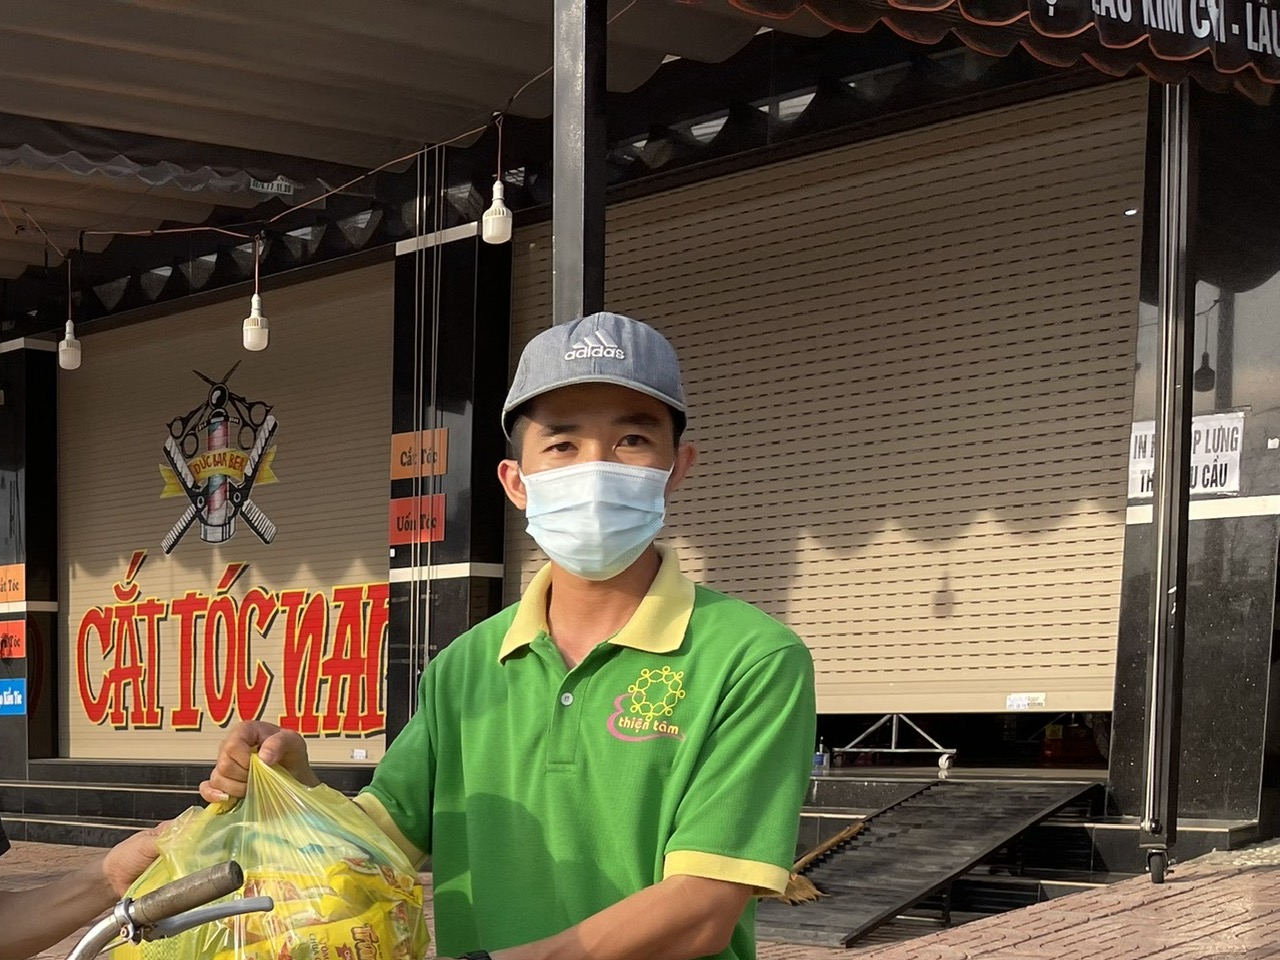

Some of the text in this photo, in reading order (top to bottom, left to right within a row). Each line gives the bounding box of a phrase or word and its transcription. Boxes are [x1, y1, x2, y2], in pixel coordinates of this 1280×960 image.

[564, 344, 625, 361] adidas
[1133, 434, 1148, 459] IN
[1205, 425, 1239, 454] LƯNG
[76, 550, 167, 728] CẮT
[170, 561, 280, 728] TÓC
[618, 717, 679, 735] thiện tâm
